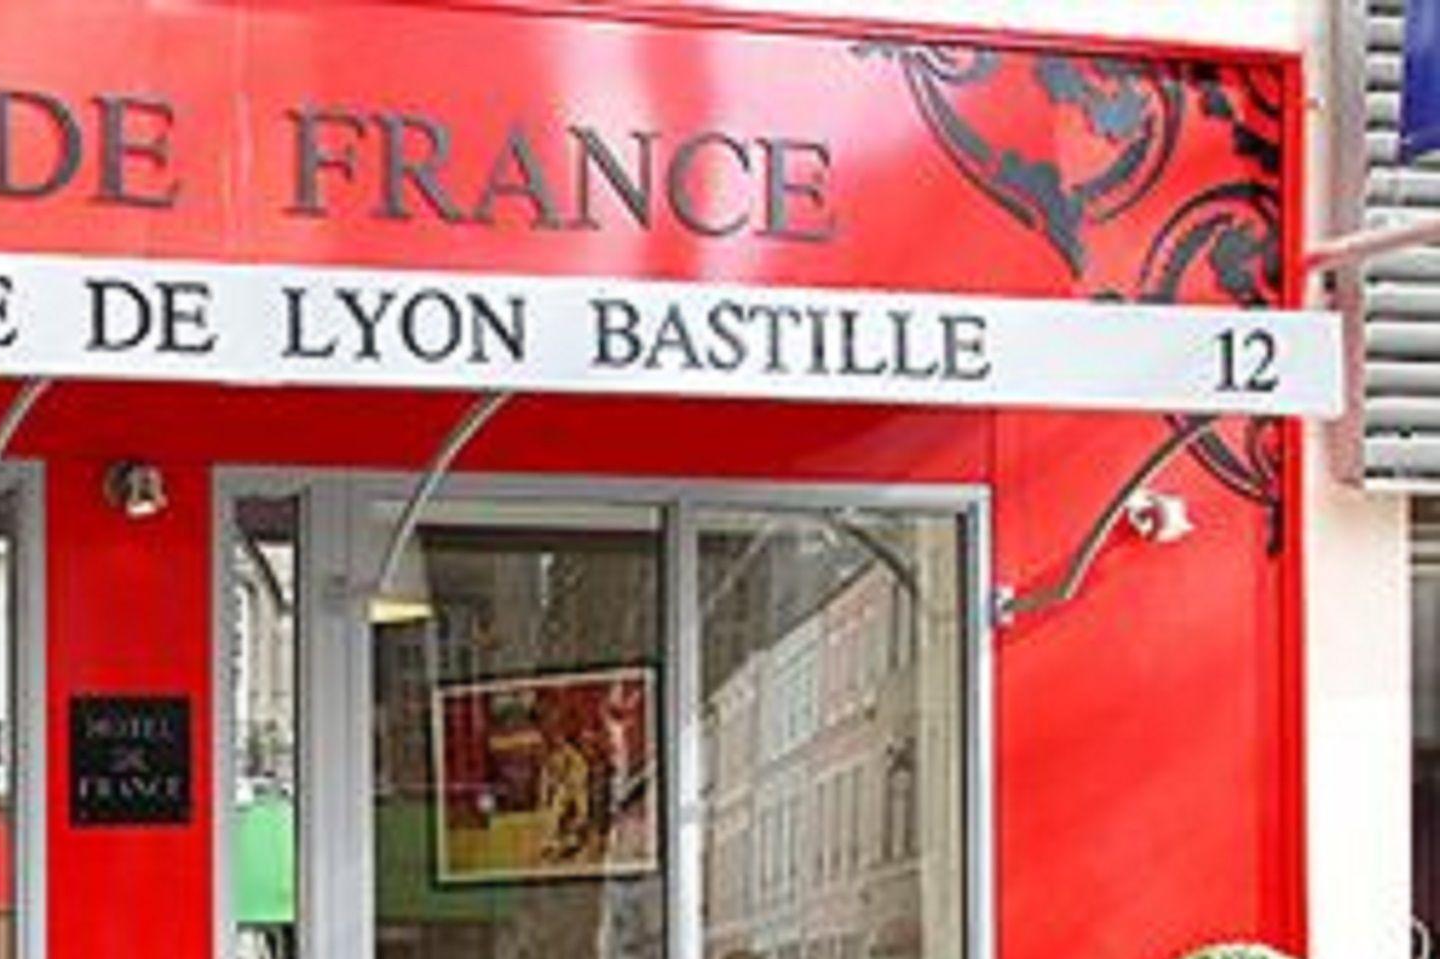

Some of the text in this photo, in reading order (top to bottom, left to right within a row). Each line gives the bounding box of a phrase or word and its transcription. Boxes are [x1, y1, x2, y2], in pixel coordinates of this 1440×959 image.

[286, 105, 840, 246] FRANCE
[84, 279, 218, 353] DE
[280, 287, 528, 363] LYON
[590, 299, 993, 383] BASTILLE
[1212, 330, 1278, 394] 12
